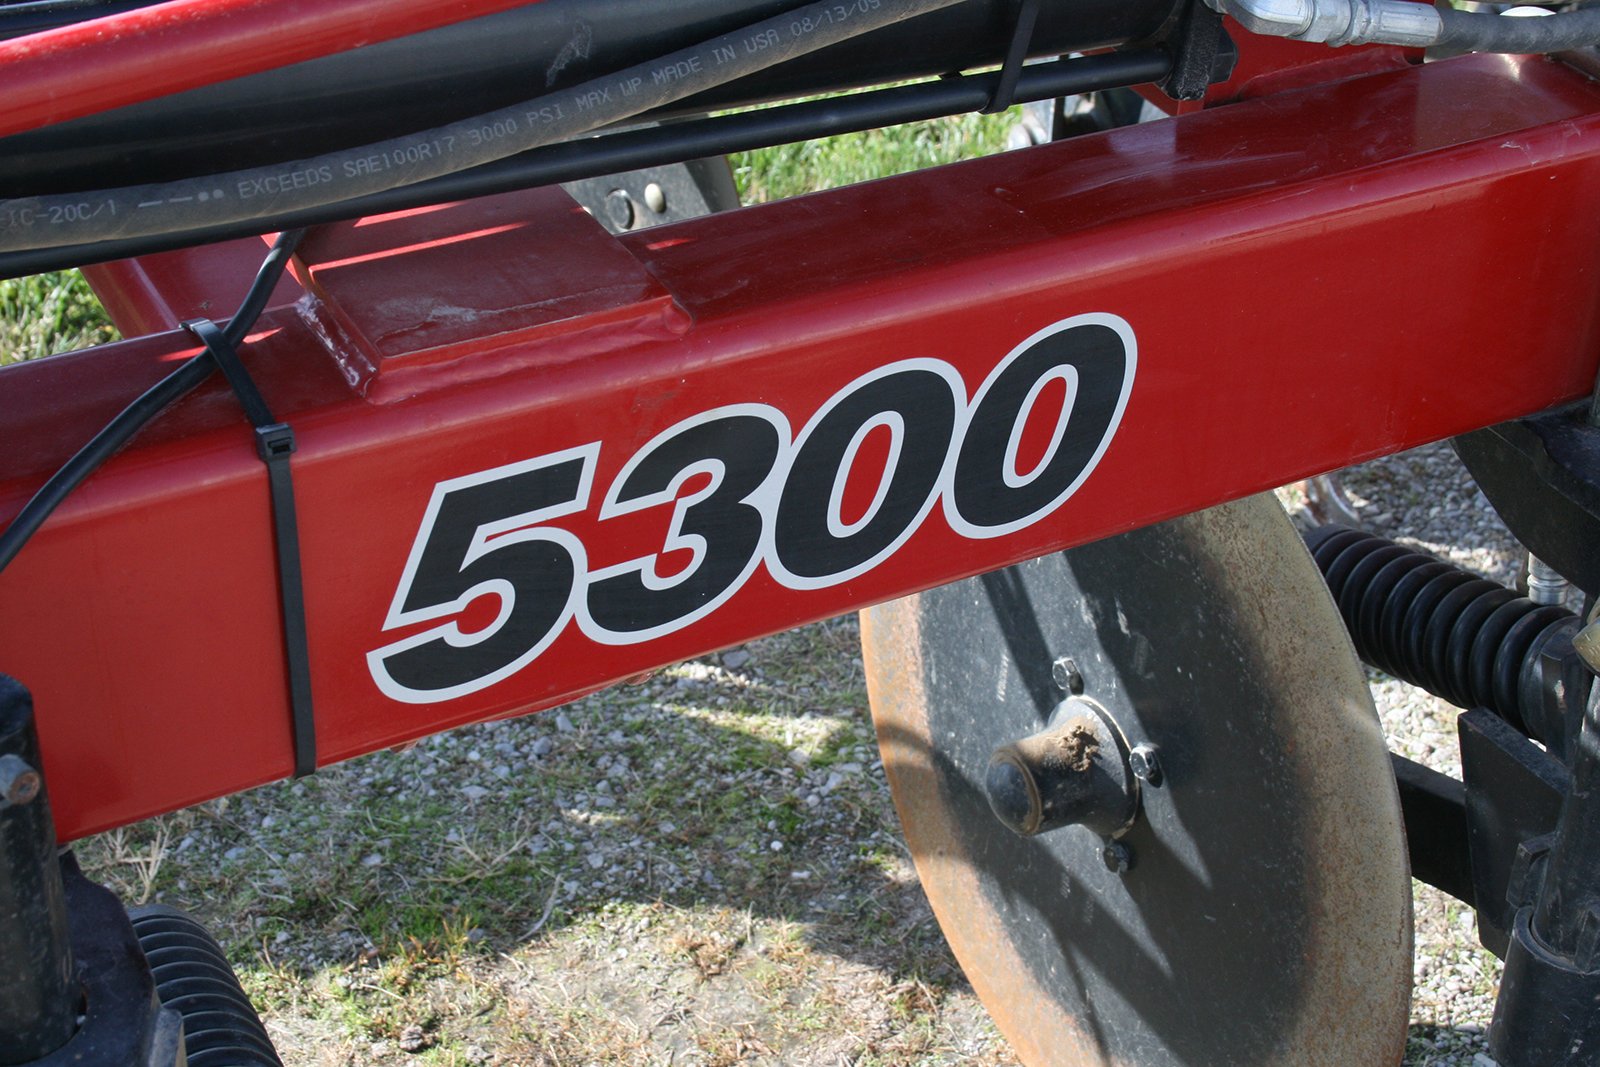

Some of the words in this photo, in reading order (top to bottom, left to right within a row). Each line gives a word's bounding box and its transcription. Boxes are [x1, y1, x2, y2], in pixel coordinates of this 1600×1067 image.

[238, 165, 333, 199] EXCEEDS
[343, 136, 456, 178] SAE100R17
[467, 118, 518, 147] 3000
[526, 103, 566, 128] PSI
[575, 87, 614, 113] MAX
[652, 55, 704, 86] MADE
[712, 44, 737, 65] IN
[744, 28, 781, 53] USA
[366, 311, 1138, 705] 5300
